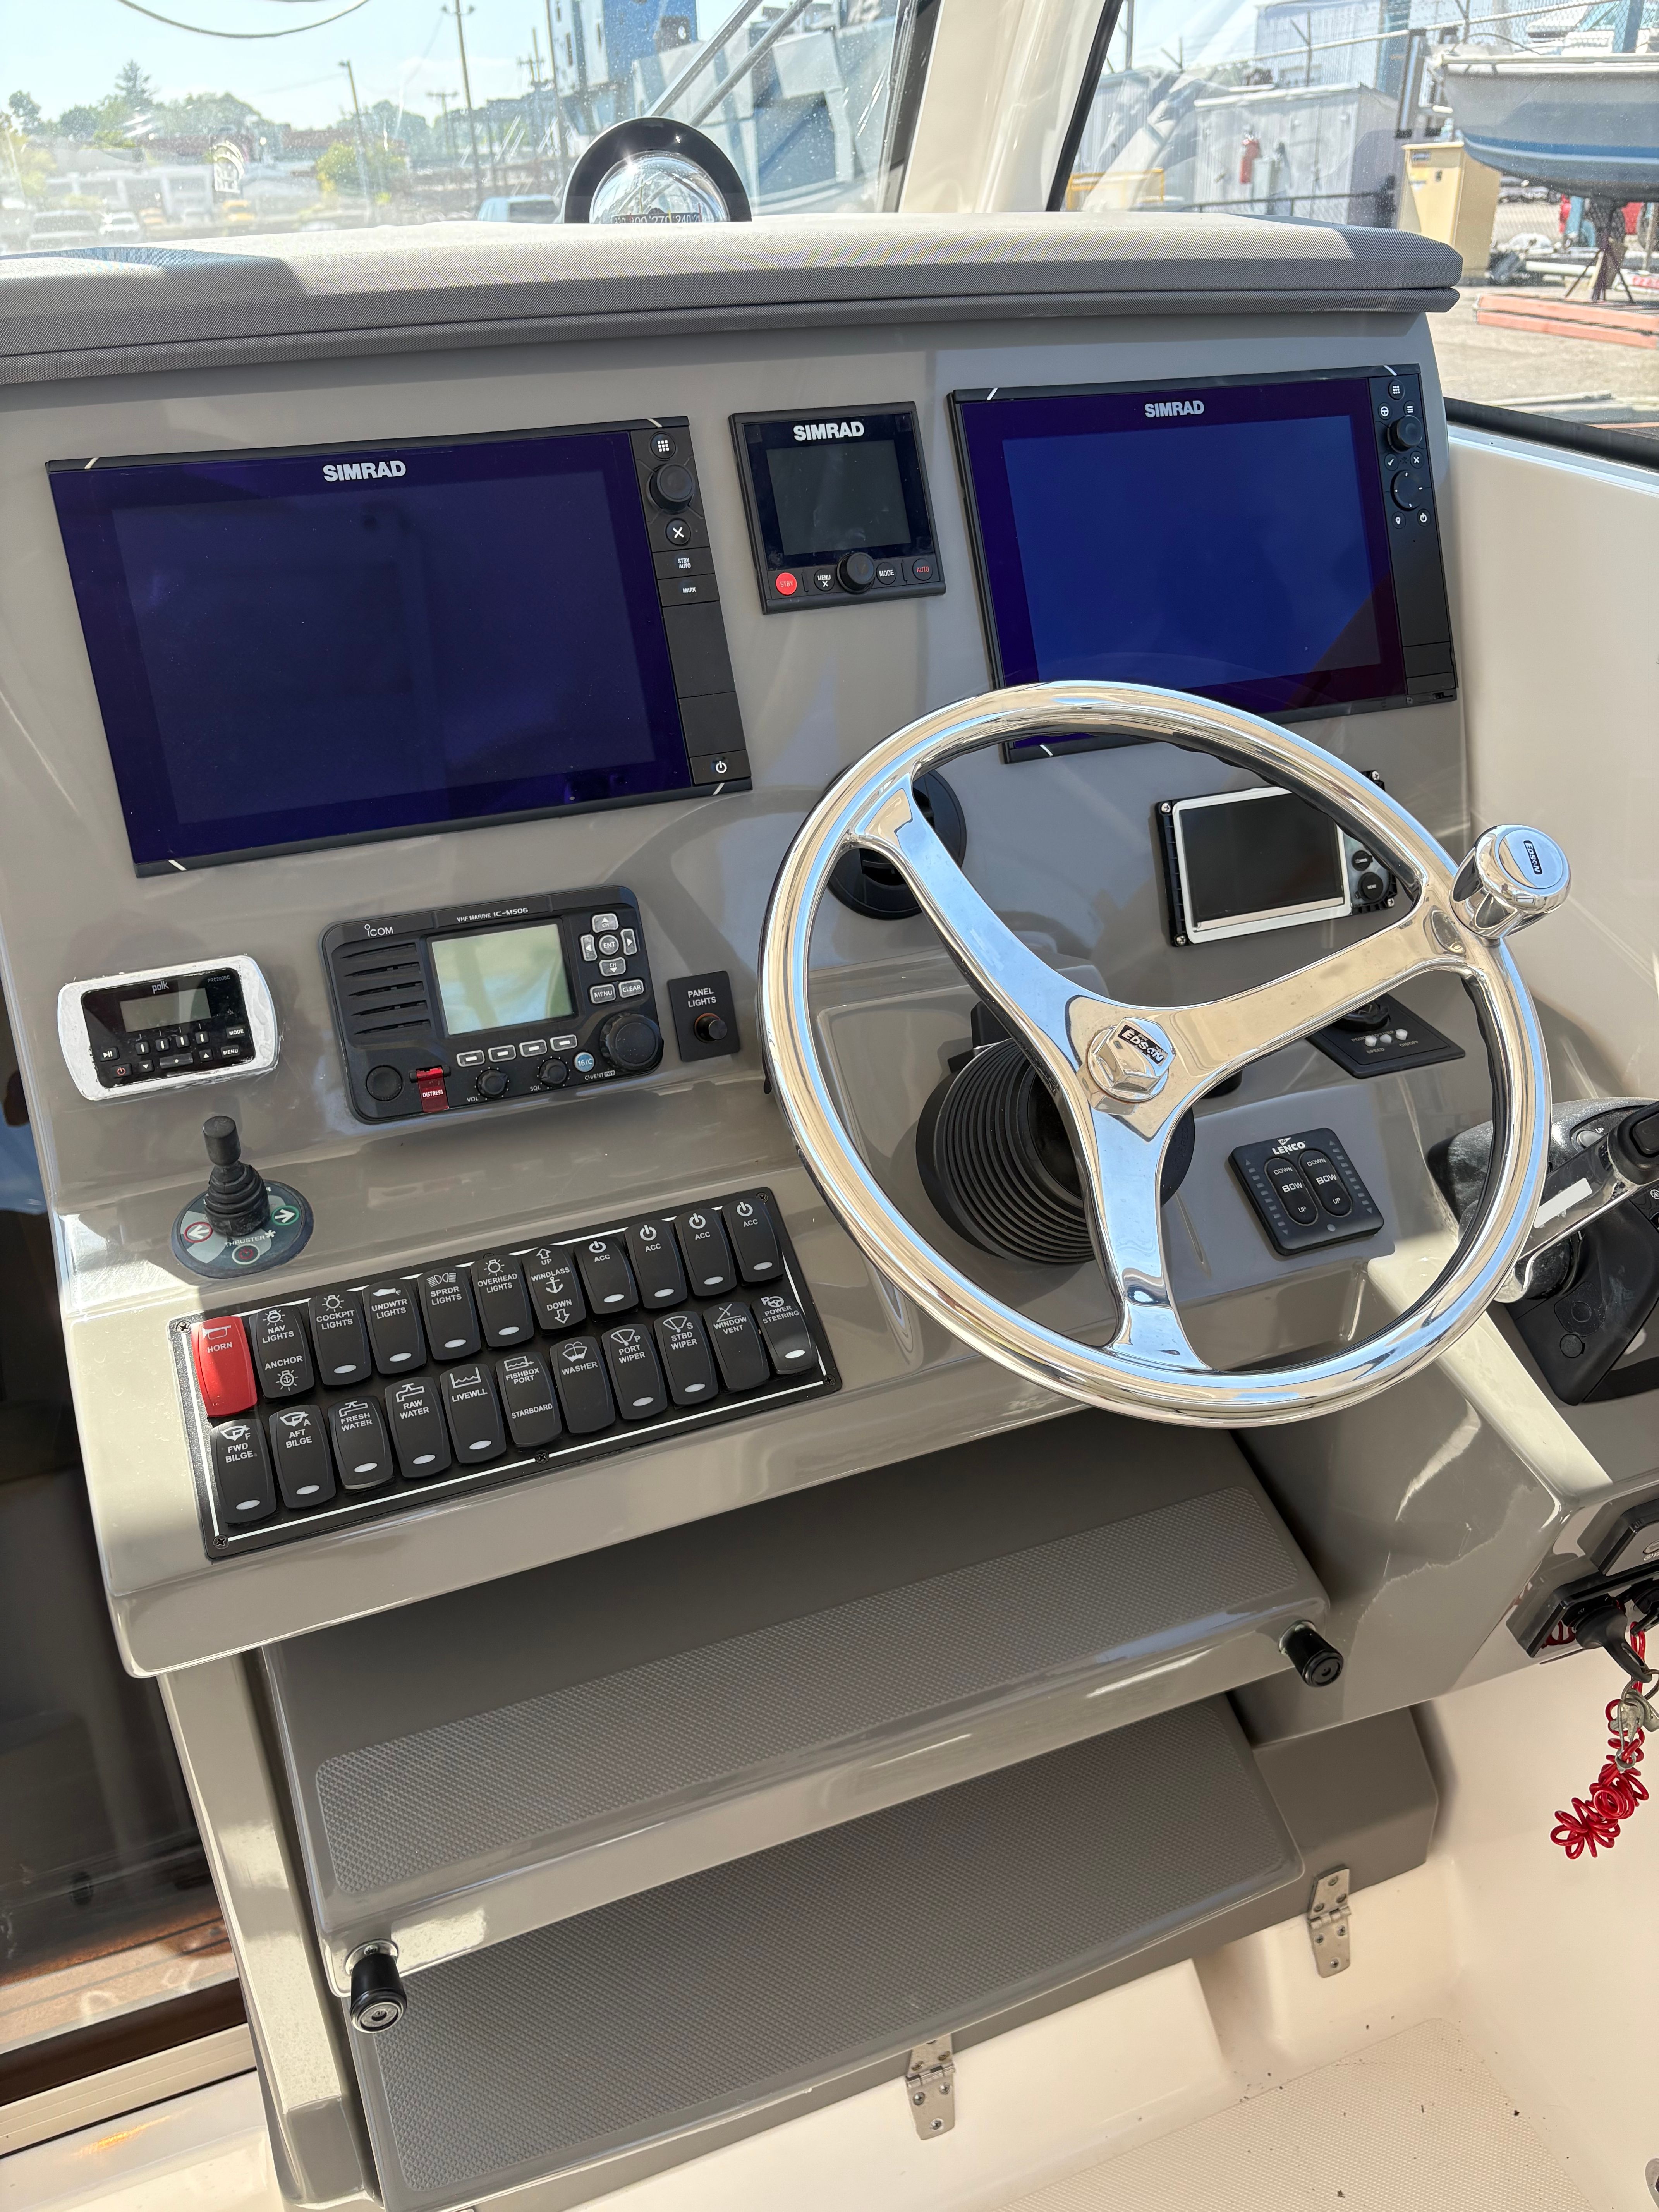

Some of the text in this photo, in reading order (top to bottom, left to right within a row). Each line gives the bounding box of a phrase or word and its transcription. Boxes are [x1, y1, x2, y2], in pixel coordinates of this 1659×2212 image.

[1144, 400, 1204, 417] SIMRAD
[793, 421, 864, 441] SIMRAD
[323, 460, 406, 481] SIMRAD
[1524, 842, 1540, 872] EDSON
[493, 908, 528, 917] IC-M506
[152, 981, 169, 993] polk
[688, 988, 713, 998] PANEL
[688, 996, 716, 1007] LIGHTS
[1121, 1029, 1164, 1061] EDSON
[422, 1089, 443, 1098] DISTRESS
[1272, 1142, 1305, 1155] LENCO
[1307, 1158, 1326, 1166] DOWN
[1316, 1174, 1336, 1184] BOW
[1282, 1182, 1303, 1192] BOW
[743, 1219, 757, 1227] ACC
[225, 1235, 264, 1247] THRUSTER
[695, 1231, 710, 1240] ACC
[646, 1243, 661, 1252] ACC
[477, 1273, 517, 1287] OVERHEAD
[531, 1267, 570, 1281] WINDLASS
[431, 1286, 459, 1297] SPRDR
[486, 1282, 512, 1293] LIGHTS
[371, 1298, 407, 1311] UNDWTR
[431, 1293, 462, 1305] LIGHTS
[546, 1299, 572, 1311] DOWN
[316, 1310, 354, 1322] COCKPIT
[376, 1307, 406, 1319] LIGHTS
[763, 1310, 799, 1323] STEERING
[764, 1305, 792, 1316] POWER
[268, 1325, 285, 1333] NAV
[321, 1319, 352, 1329] LIGHTS
[713, 1317, 746, 1329] WINDOW
[723, 1324, 743, 1334] VENT
[263, 1331, 294, 1343] LIGHTS
[671, 1332, 692, 1341] STBD
[207, 1342, 232, 1353] HORN
[619, 1345, 640, 1355] PORT
[671, 1338, 697, 1350] WIPER
[264, 1355, 302, 1370] ANCHOR
[619, 1352, 645, 1363] WIPER
[561, 1361, 598, 1375] WASHER
[505, 1368, 539, 1381] FISHBOX
[513, 1375, 534, 1384] PORT
[452, 1388, 487, 1402] LIVEWLL
[403, 1400, 422, 1409] RAW
[511, 1403, 553, 1418] STARBOARD
[340, 1412, 370, 1424] FRESH
[400, 1407, 429, 1419] WATER
[341, 1419, 372, 1431] WATER
[289, 1429, 305, 1439] AFT
[228, 1443, 248, 1453] FWD
[286, 1436, 312, 1448] BILGE
[225, 1451, 253, 1463] BILGE
